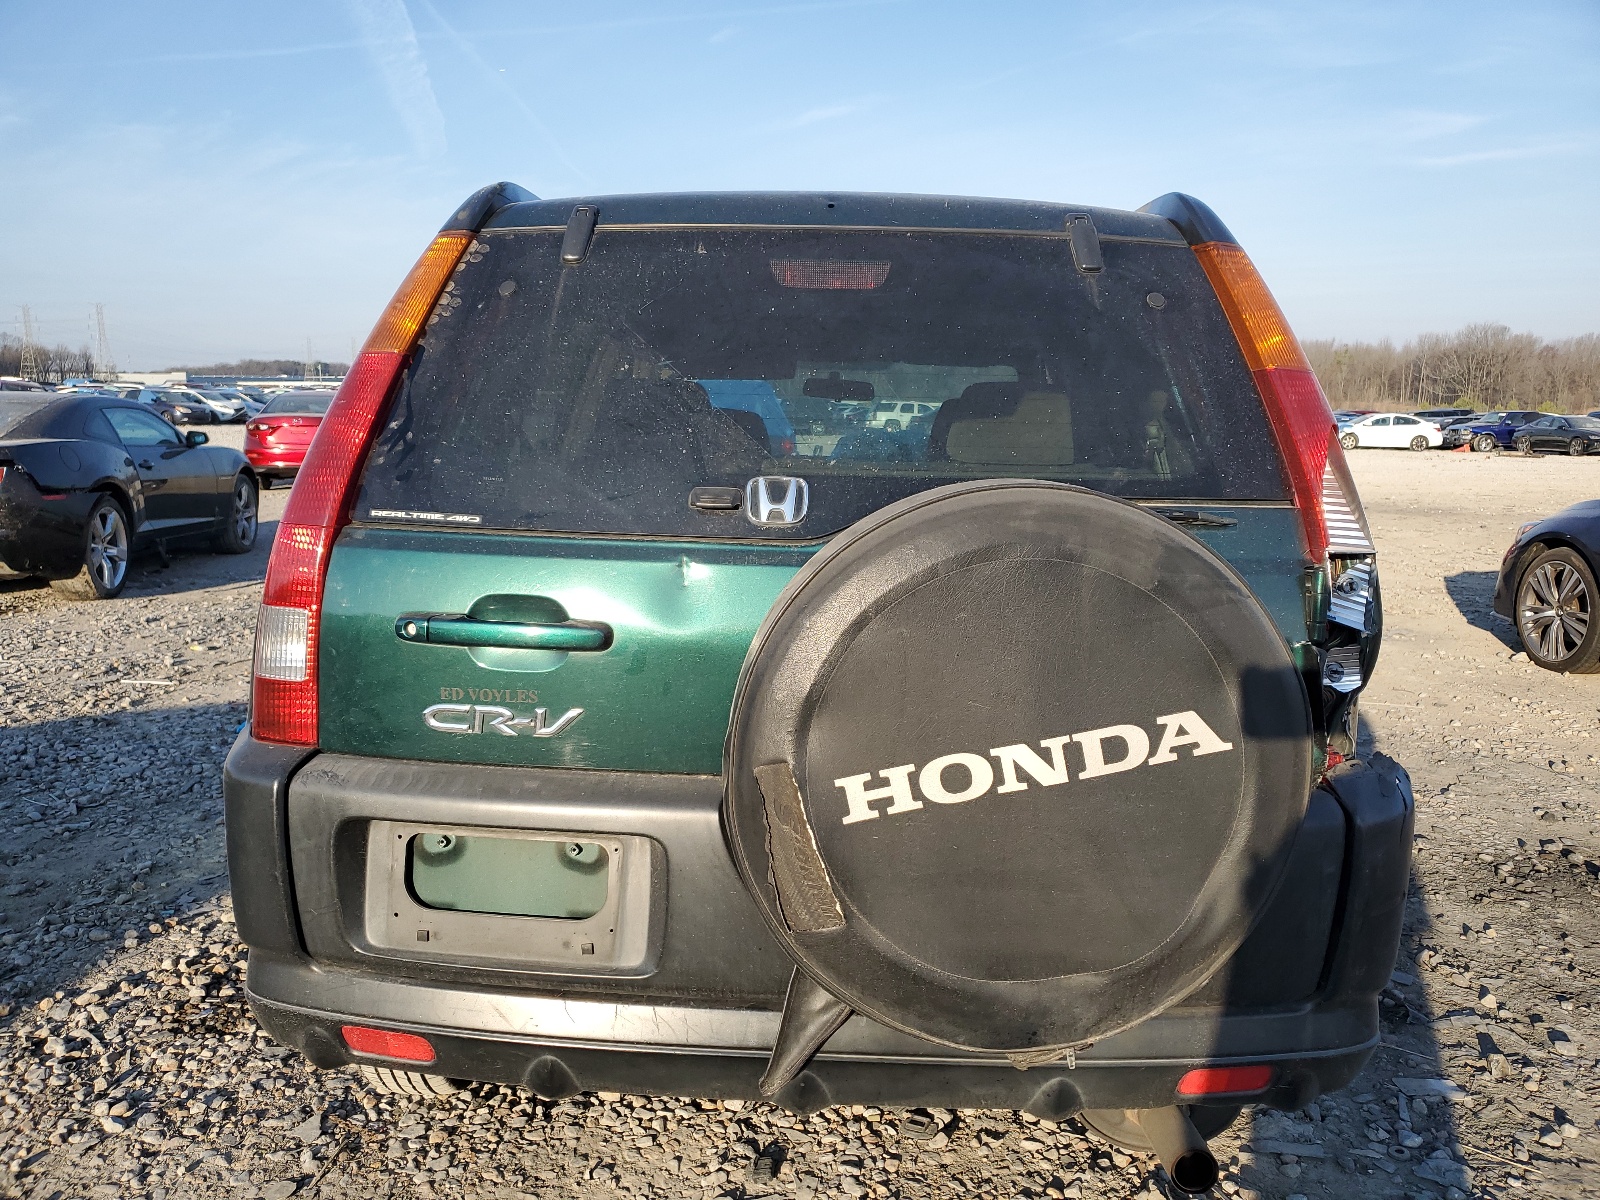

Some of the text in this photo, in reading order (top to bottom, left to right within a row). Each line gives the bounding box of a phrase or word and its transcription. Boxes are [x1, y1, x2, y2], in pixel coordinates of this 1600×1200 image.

[440, 687, 538, 703] ED VOYLES
[423, 703, 585, 737] CR-V
[834, 710, 1233, 825] HONDA
